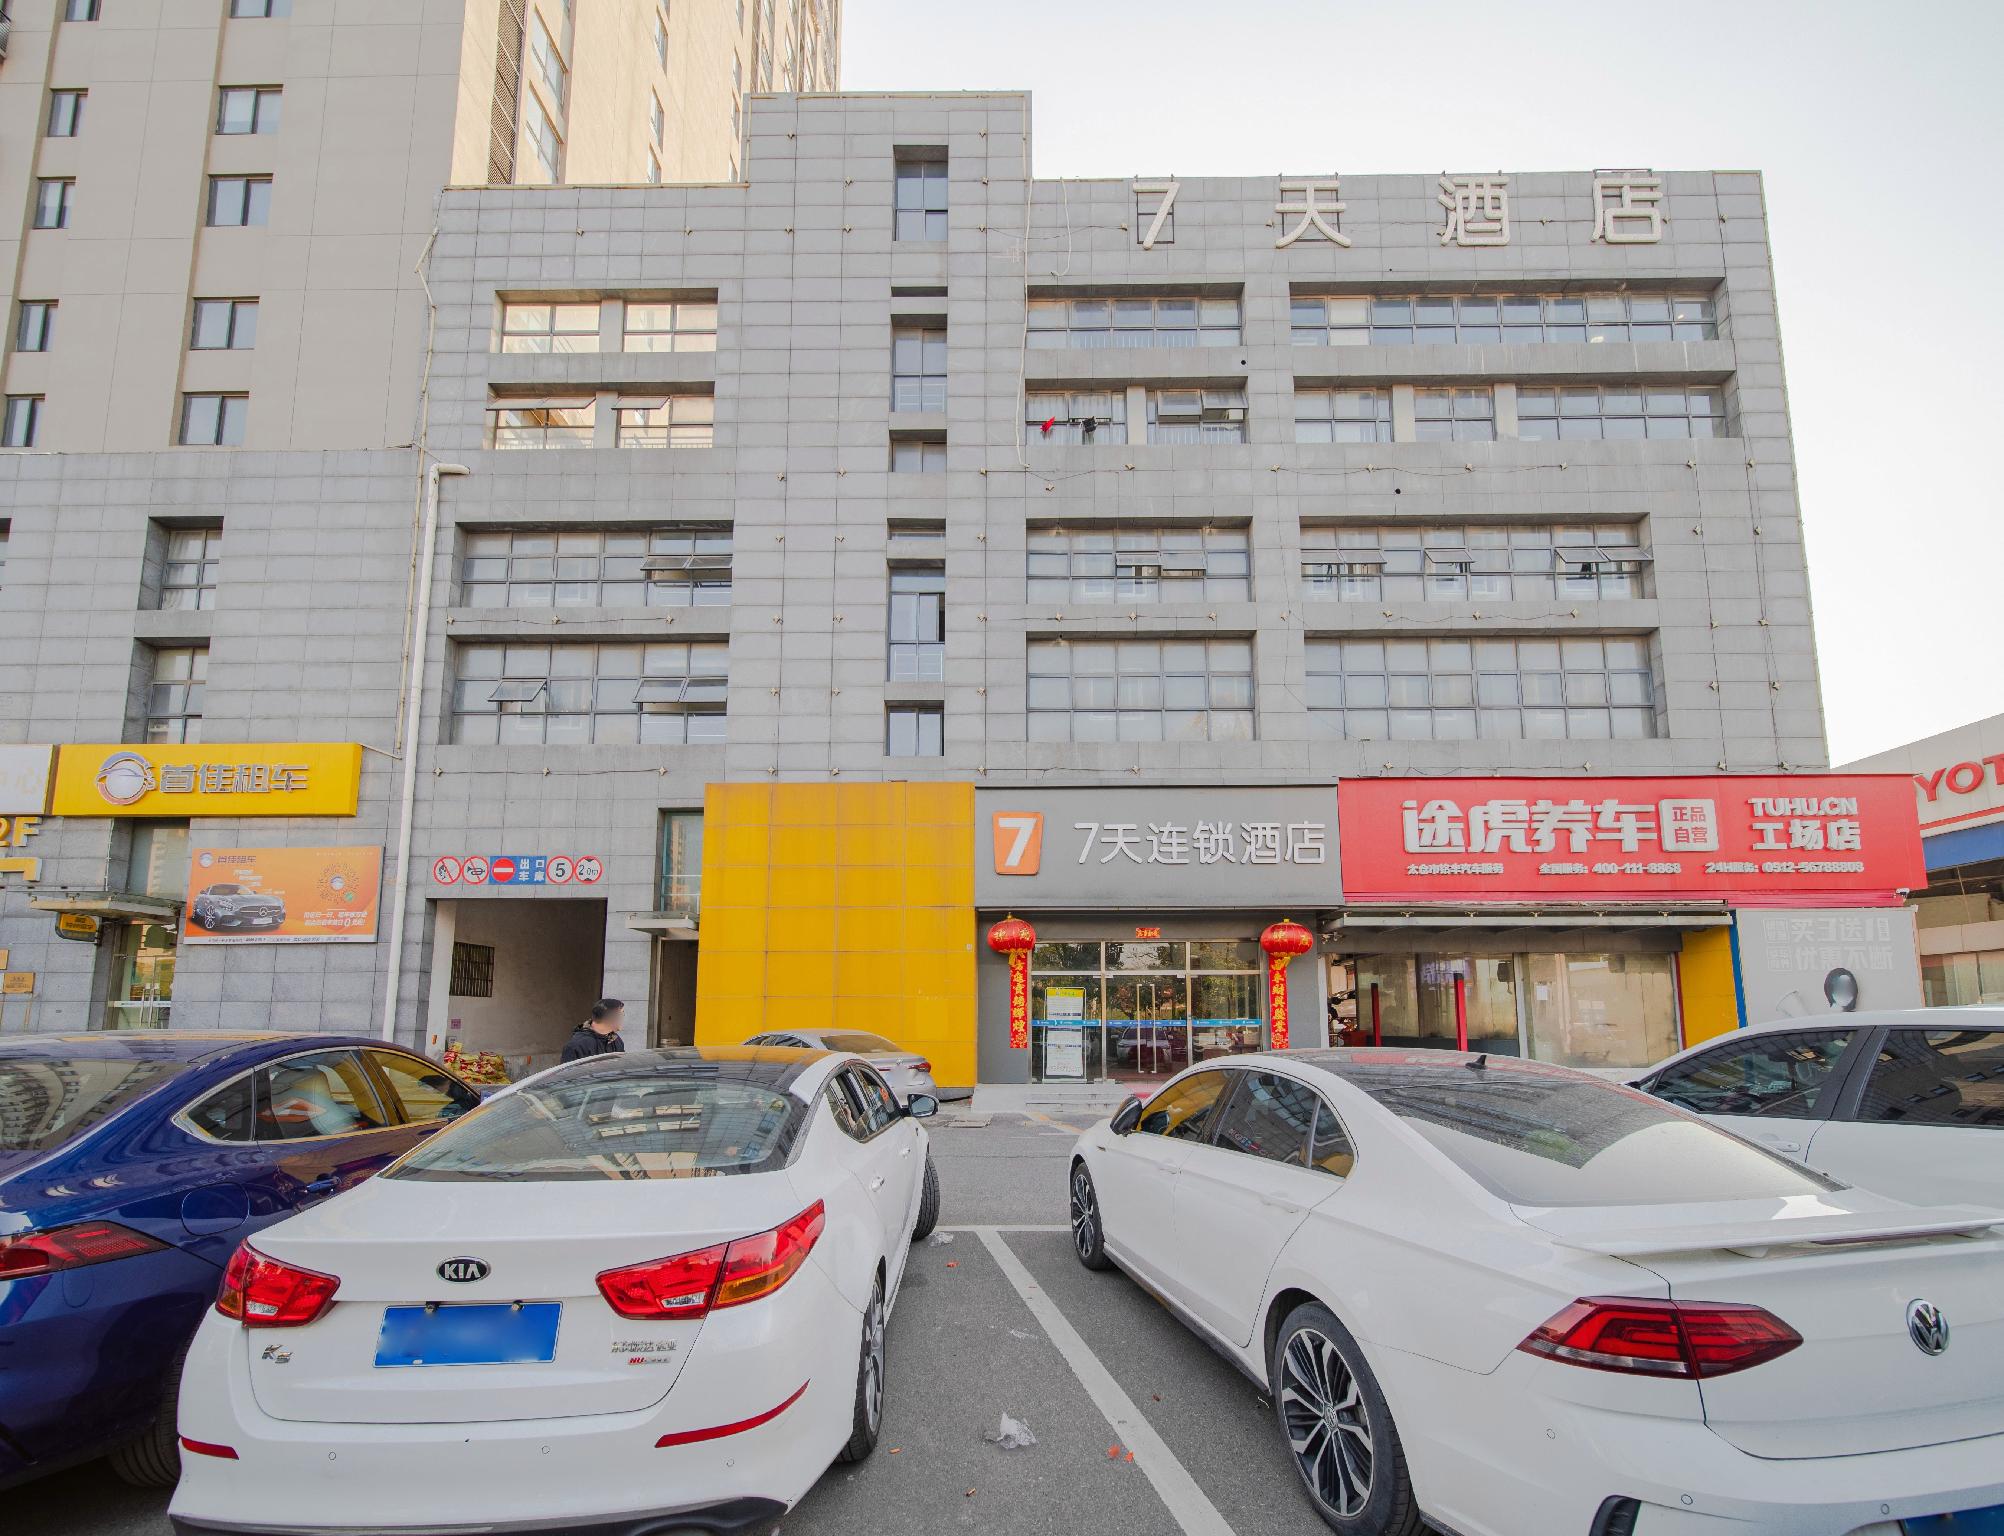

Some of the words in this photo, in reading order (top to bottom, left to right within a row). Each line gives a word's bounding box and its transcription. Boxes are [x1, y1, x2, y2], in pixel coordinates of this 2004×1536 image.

[1132, 173, 1664, 250] 7天酒店
[159, 763, 309, 794] 首佳租车
[1672, 805, 1706, 822] 正品
[1748, 796, 1858, 817] TUHU.CN
[1402, 798, 1658, 854] 途虎养车
[1674, 826, 1709, 844] 自营
[1751, 818, 1862, 852] 工场店
[998, 817, 1037, 867] 7
[1073, 820, 1327, 865] 7天连锁酒店
[555, 862, 566, 878] 5
[443, 1262, 482, 1279] KIA
